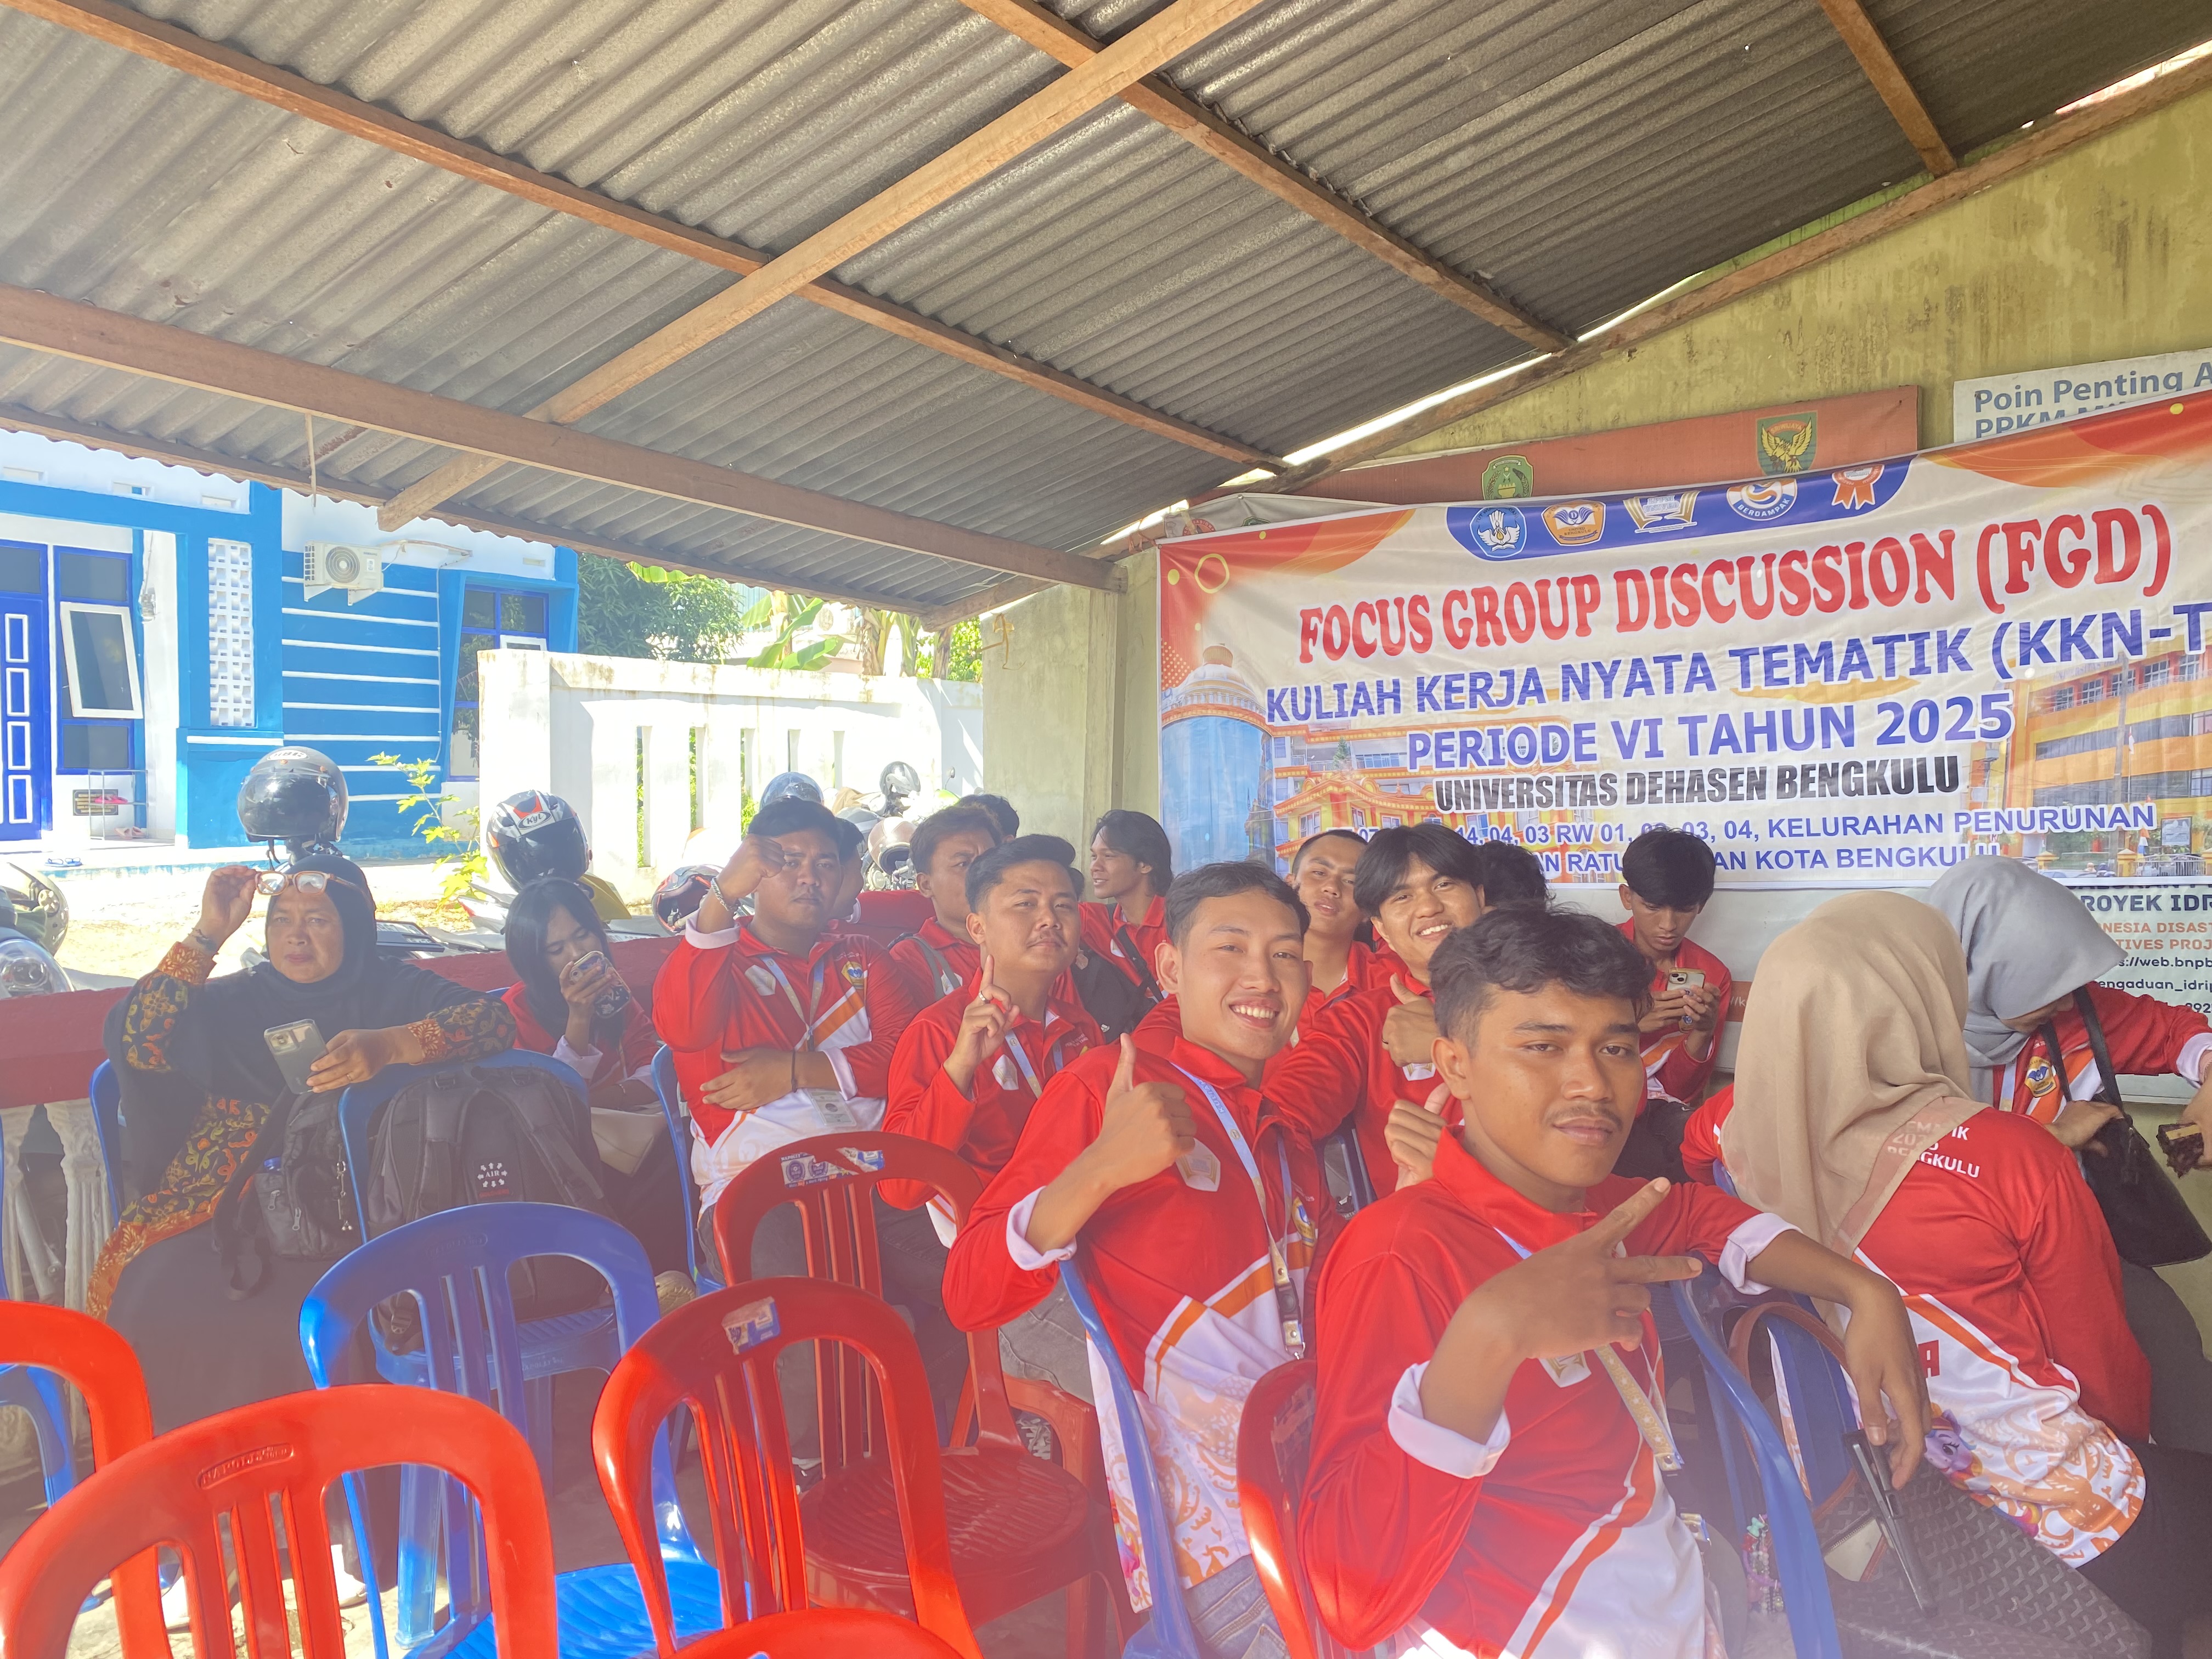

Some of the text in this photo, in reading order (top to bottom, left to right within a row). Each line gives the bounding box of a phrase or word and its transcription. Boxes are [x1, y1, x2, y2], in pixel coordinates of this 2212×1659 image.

[1975, 385, 2042, 413] Poin
[2054, 371, 2183, 403] Penting
[1737, 498, 1791, 517] BERDAMPAK
[1299, 504, 2172, 663] FOCUS GROUP DISCUSSION (FGD)
[1266, 677, 1401, 723] KULIAH
[1417, 667, 1548, 713] KERJA
[1562, 651, 1717, 703] NYATA
[1729, 628, 1974, 690] TEMATIK
[1409, 692, 2012, 770] PERIODE VI TAHUN 2025
[1434, 755, 1959, 812] UNIVERSITAS DEHASEN BENGKULU
[1526, 826, 1549, 843] 03
[1558, 825, 1594, 843] RW
[1724, 820, 1759, 842] 04,
[1769, 813, 1944, 838] KELURAHAN
[1955, 806, 2153, 833] PENURUNAN
[1756, 849, 1829, 870] KOTA
[2099, 922, 2152, 933] NESIA
